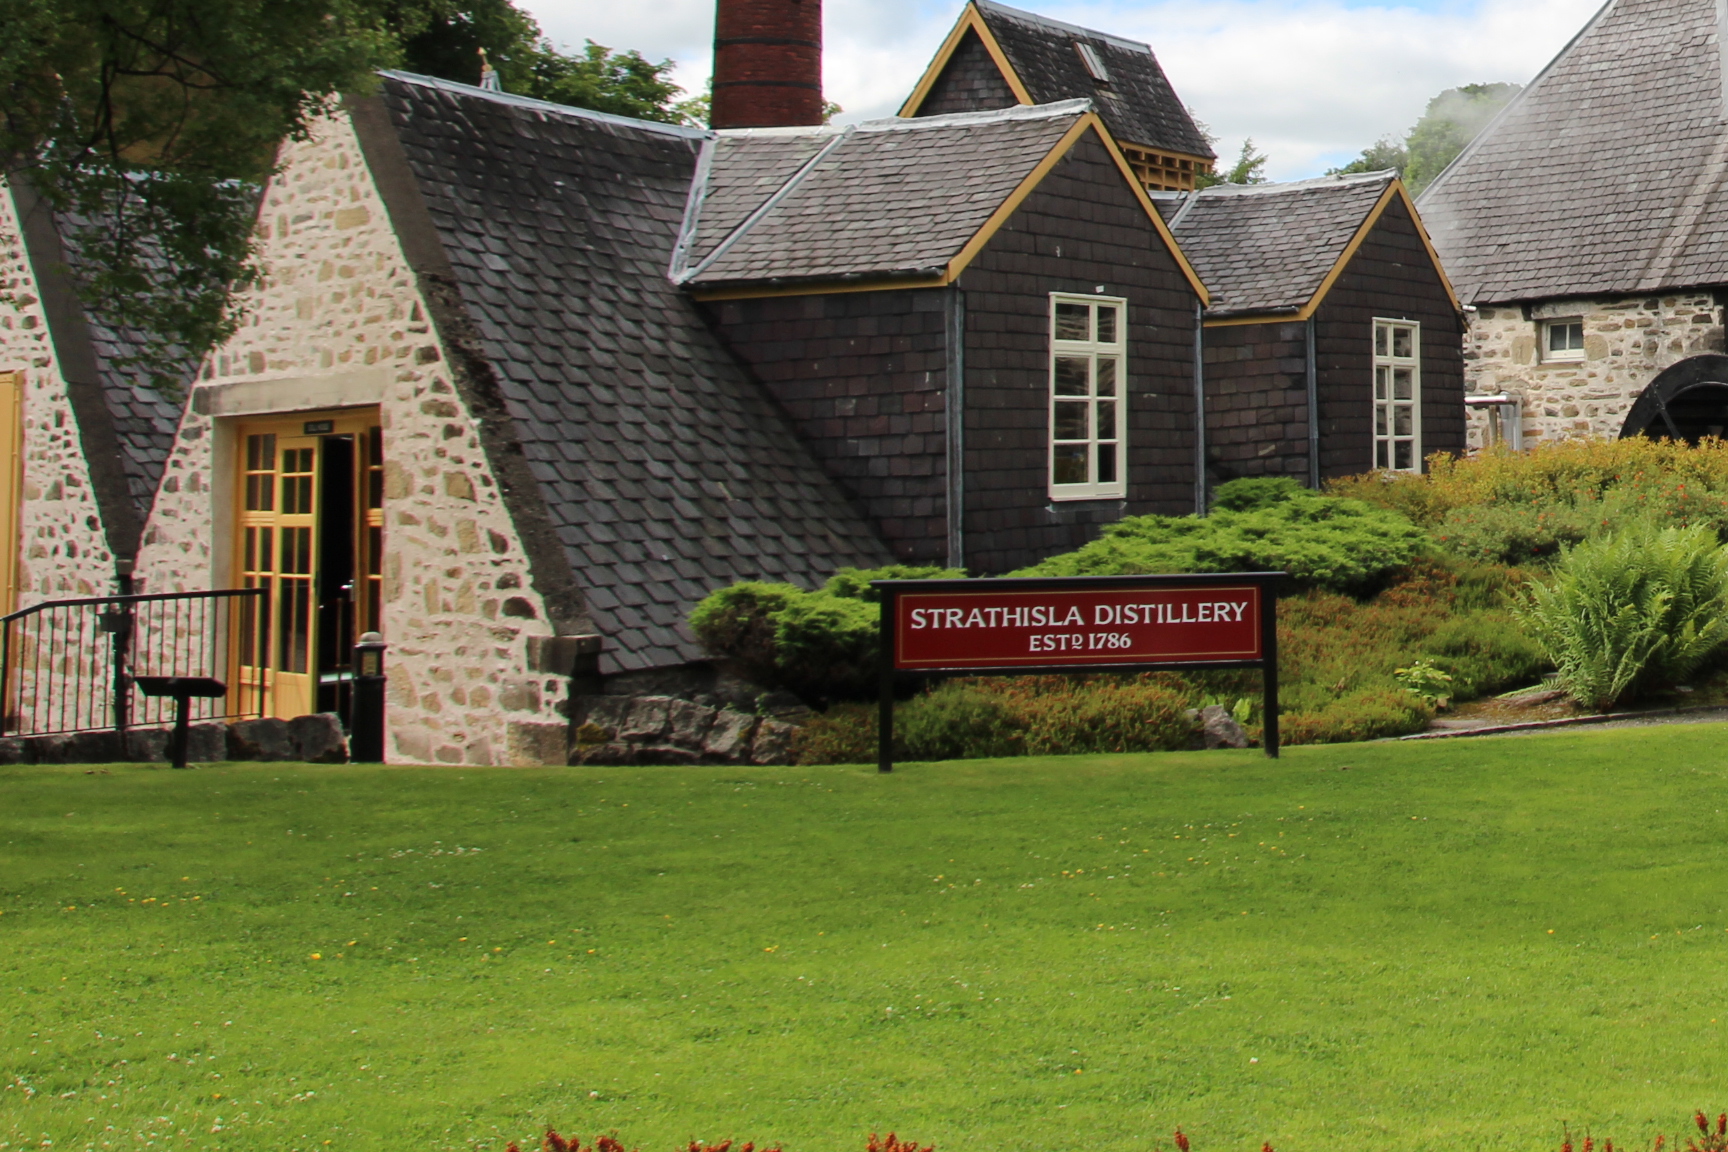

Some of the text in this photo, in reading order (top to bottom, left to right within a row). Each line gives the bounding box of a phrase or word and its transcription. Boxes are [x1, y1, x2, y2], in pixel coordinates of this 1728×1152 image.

[911, 601, 1248, 630] STRATHISLA DISTILLERY
[1029, 632, 1132, 652] ESTD 1786
